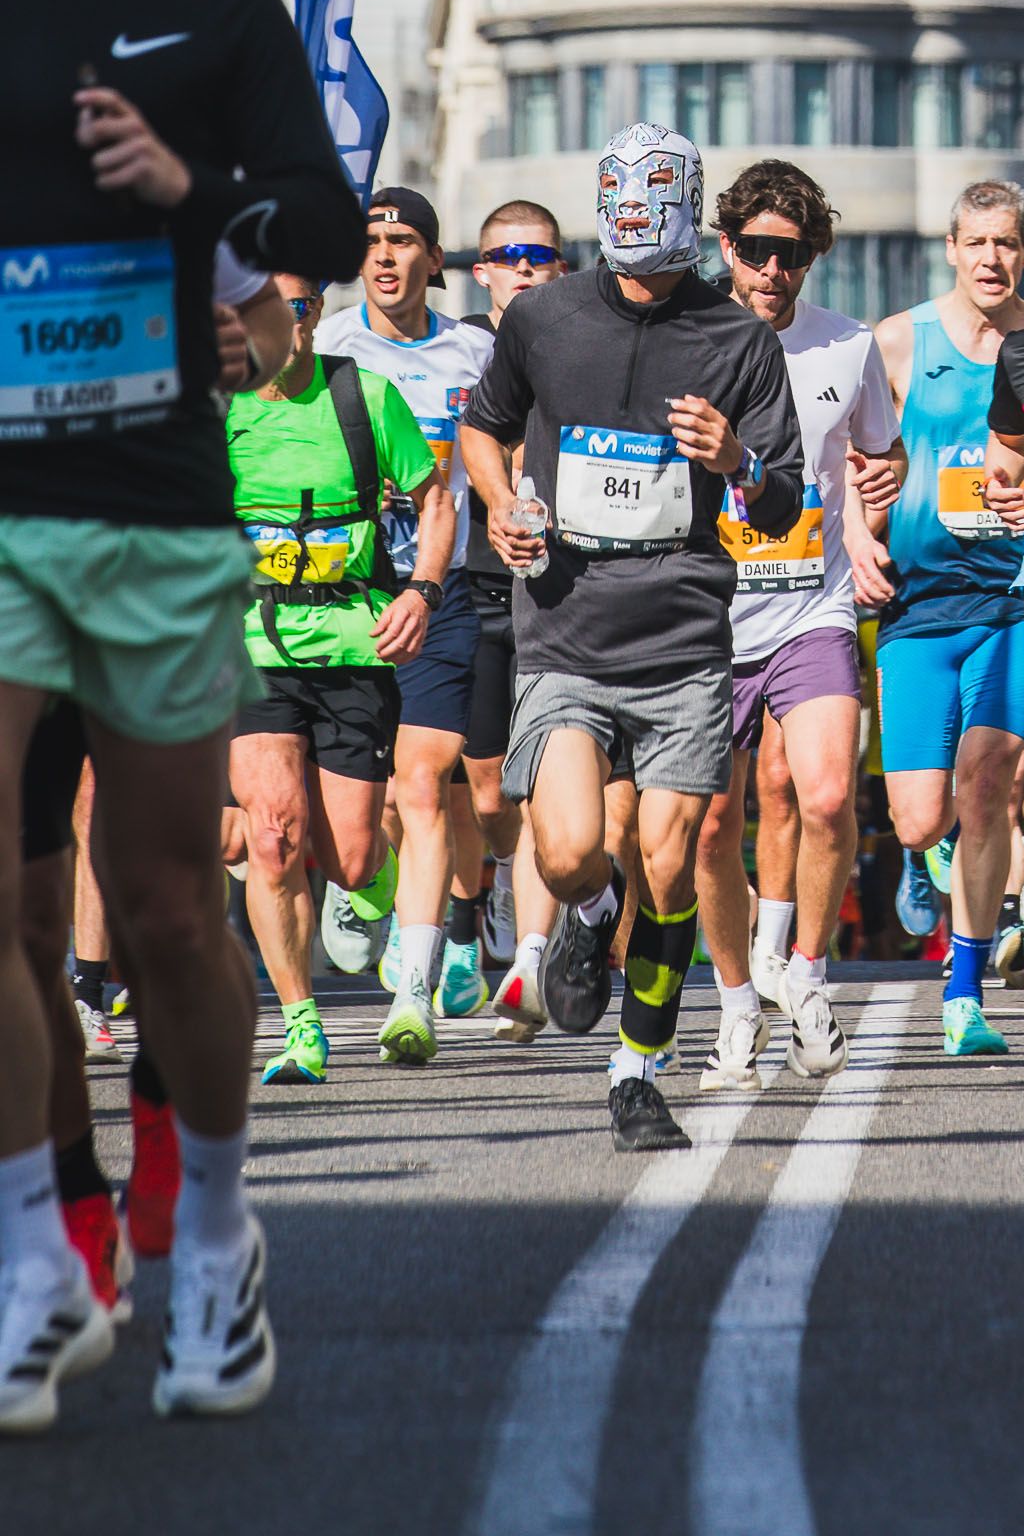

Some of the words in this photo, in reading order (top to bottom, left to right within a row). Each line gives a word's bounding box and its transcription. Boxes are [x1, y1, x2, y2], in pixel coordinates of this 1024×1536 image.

[17, 312, 124, 356] 16090
[623, 442, 670, 457] movistar
[603, 476, 641, 500] 841
[744, 562, 790, 576] DANIEL
